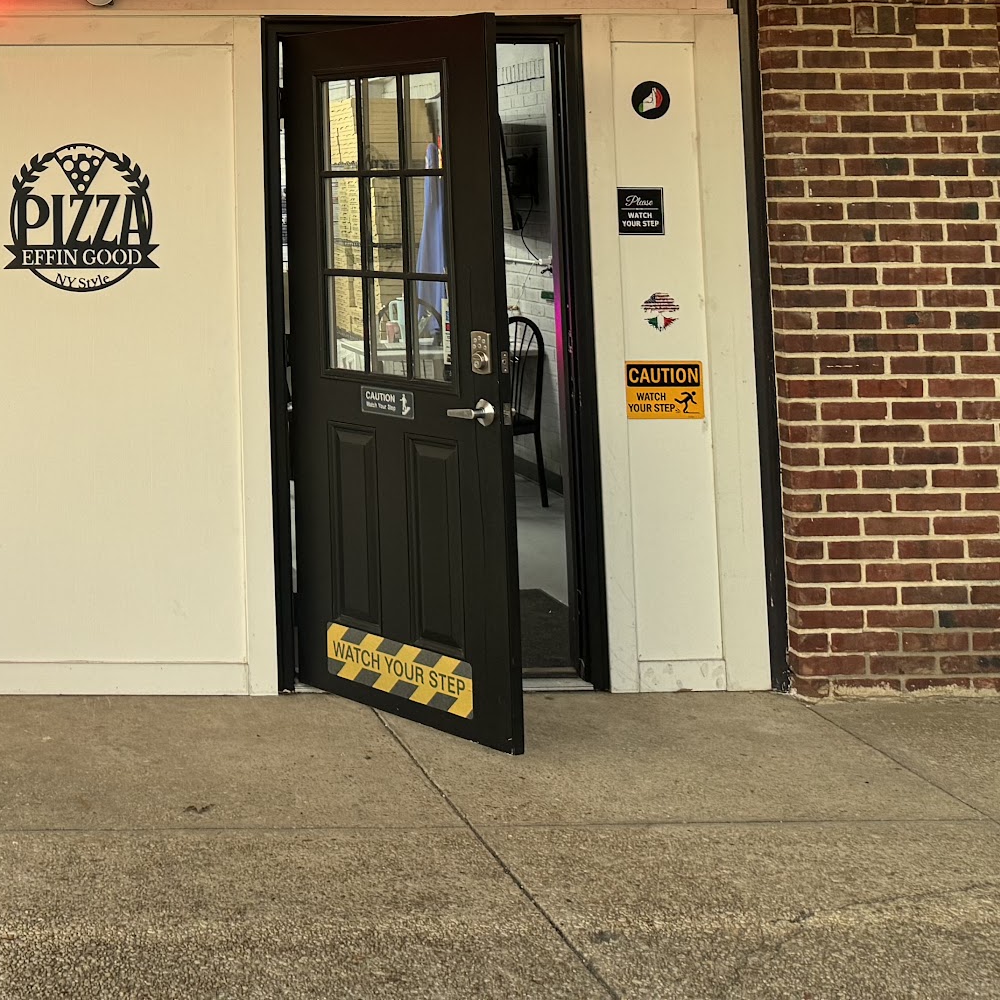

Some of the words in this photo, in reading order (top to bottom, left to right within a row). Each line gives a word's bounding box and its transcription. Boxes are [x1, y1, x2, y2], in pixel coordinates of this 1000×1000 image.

[624, 195, 654, 207] Please
[17, 194, 149, 246] PIZZA
[21, 249, 78, 266] EFFIN
[82, 248, 142, 265] GOOD
[55, 273, 77, 287] NY
[78, 273, 110, 289] Style
[628, 367, 699, 384] CAUTION
[365, 390, 396, 403] CAUTION
[636, 392, 667, 401] WATCH
[628, 403, 652, 413] YOUR
[653, 403, 676, 413] STEP
[332, 639, 381, 671] WATCH
[383, 655, 425, 685] YOUR
[428, 668, 466, 697] STEP
